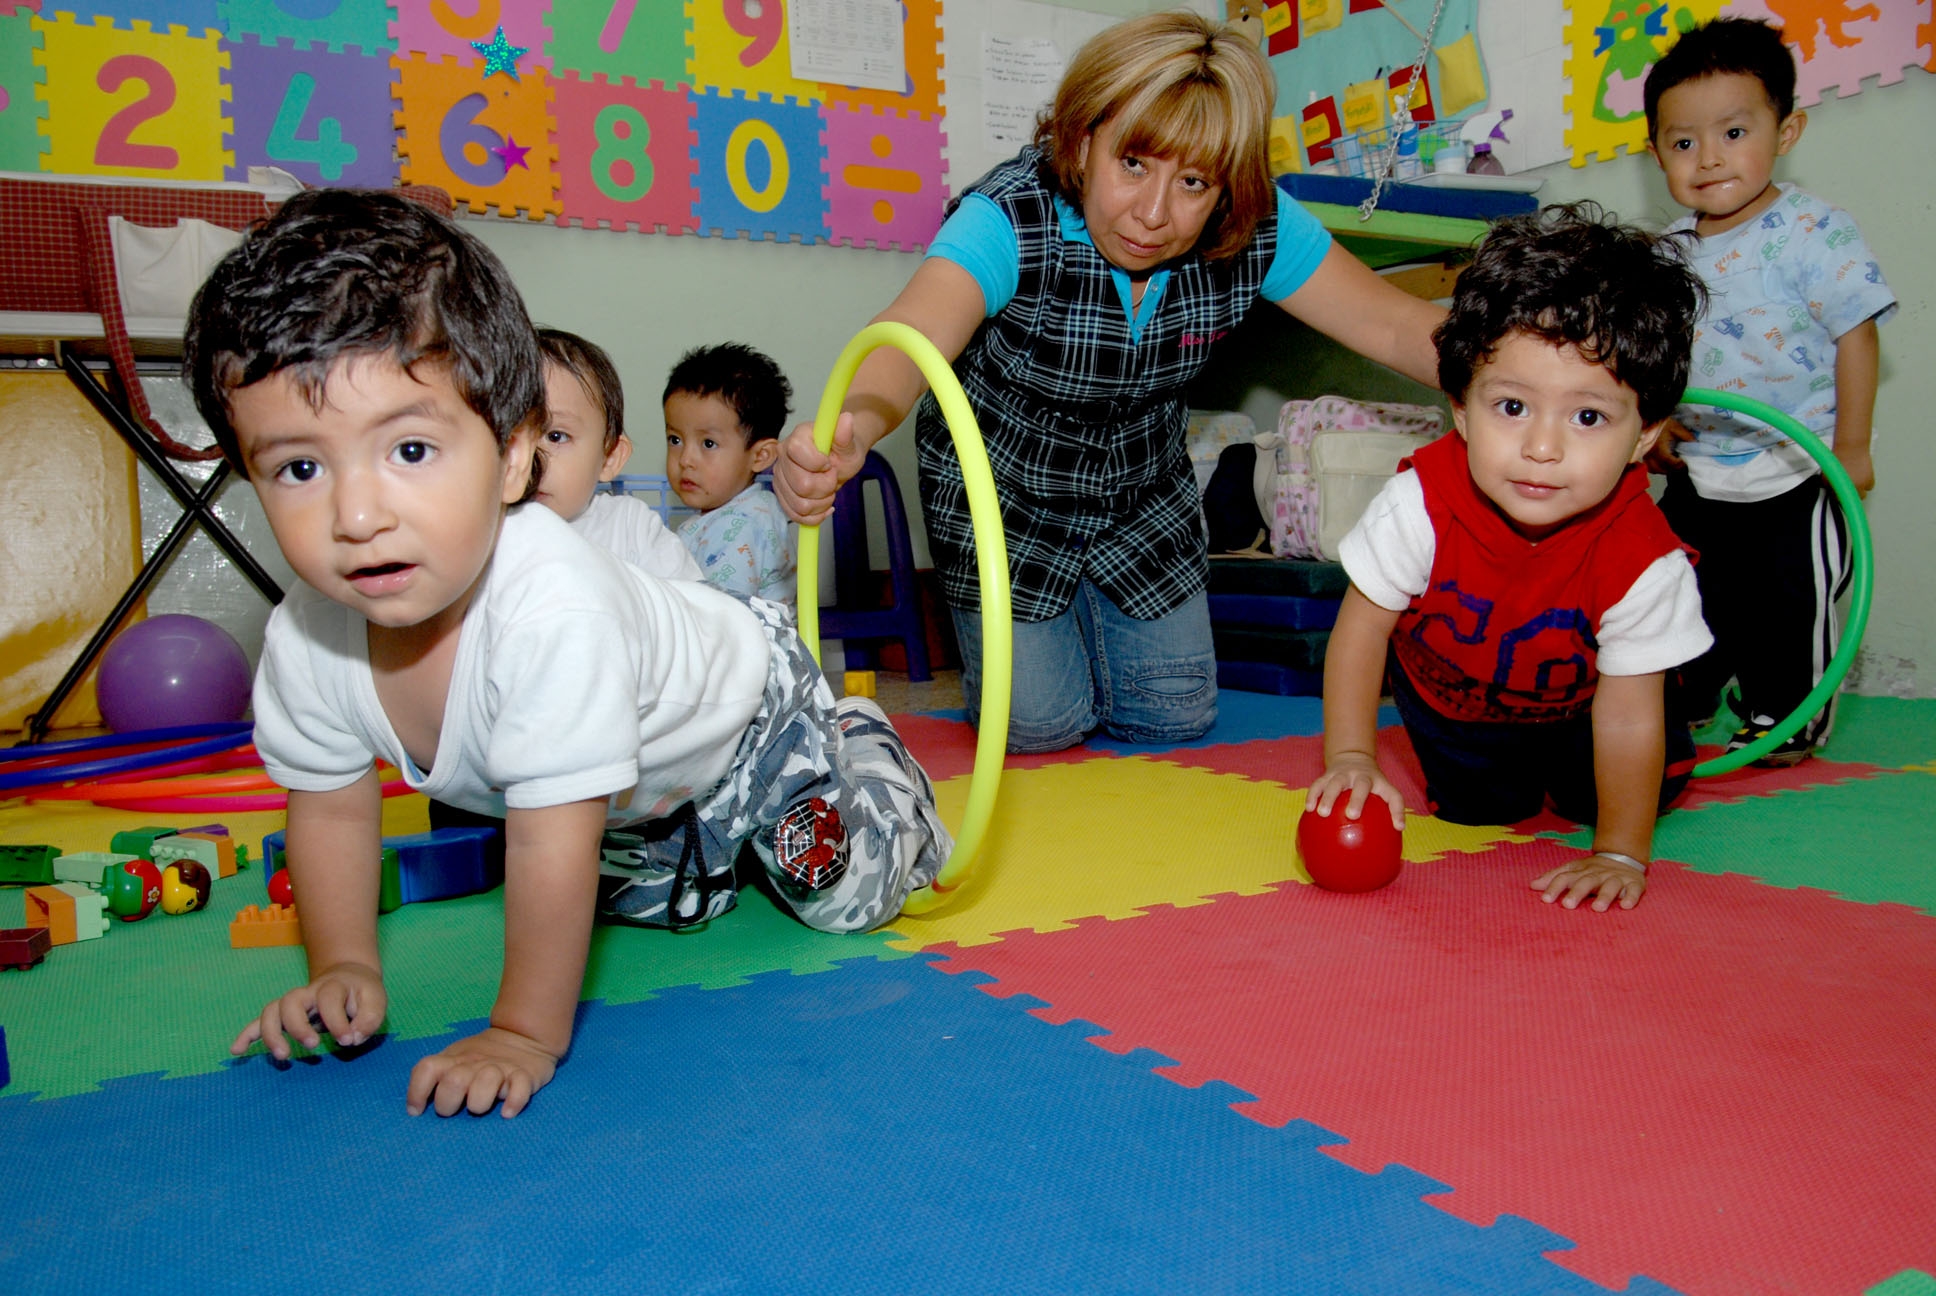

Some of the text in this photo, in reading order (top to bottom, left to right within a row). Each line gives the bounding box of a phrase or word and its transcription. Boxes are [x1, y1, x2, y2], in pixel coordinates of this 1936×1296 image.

[723, 0, 783, 67] 9
[95, 55, 179, 169] 2
[266, 73, 358, 180] 4
[441, 93, 507, 186] 6
[591, 105, 654, 202] 8
[726, 119, 789, 212] 0
